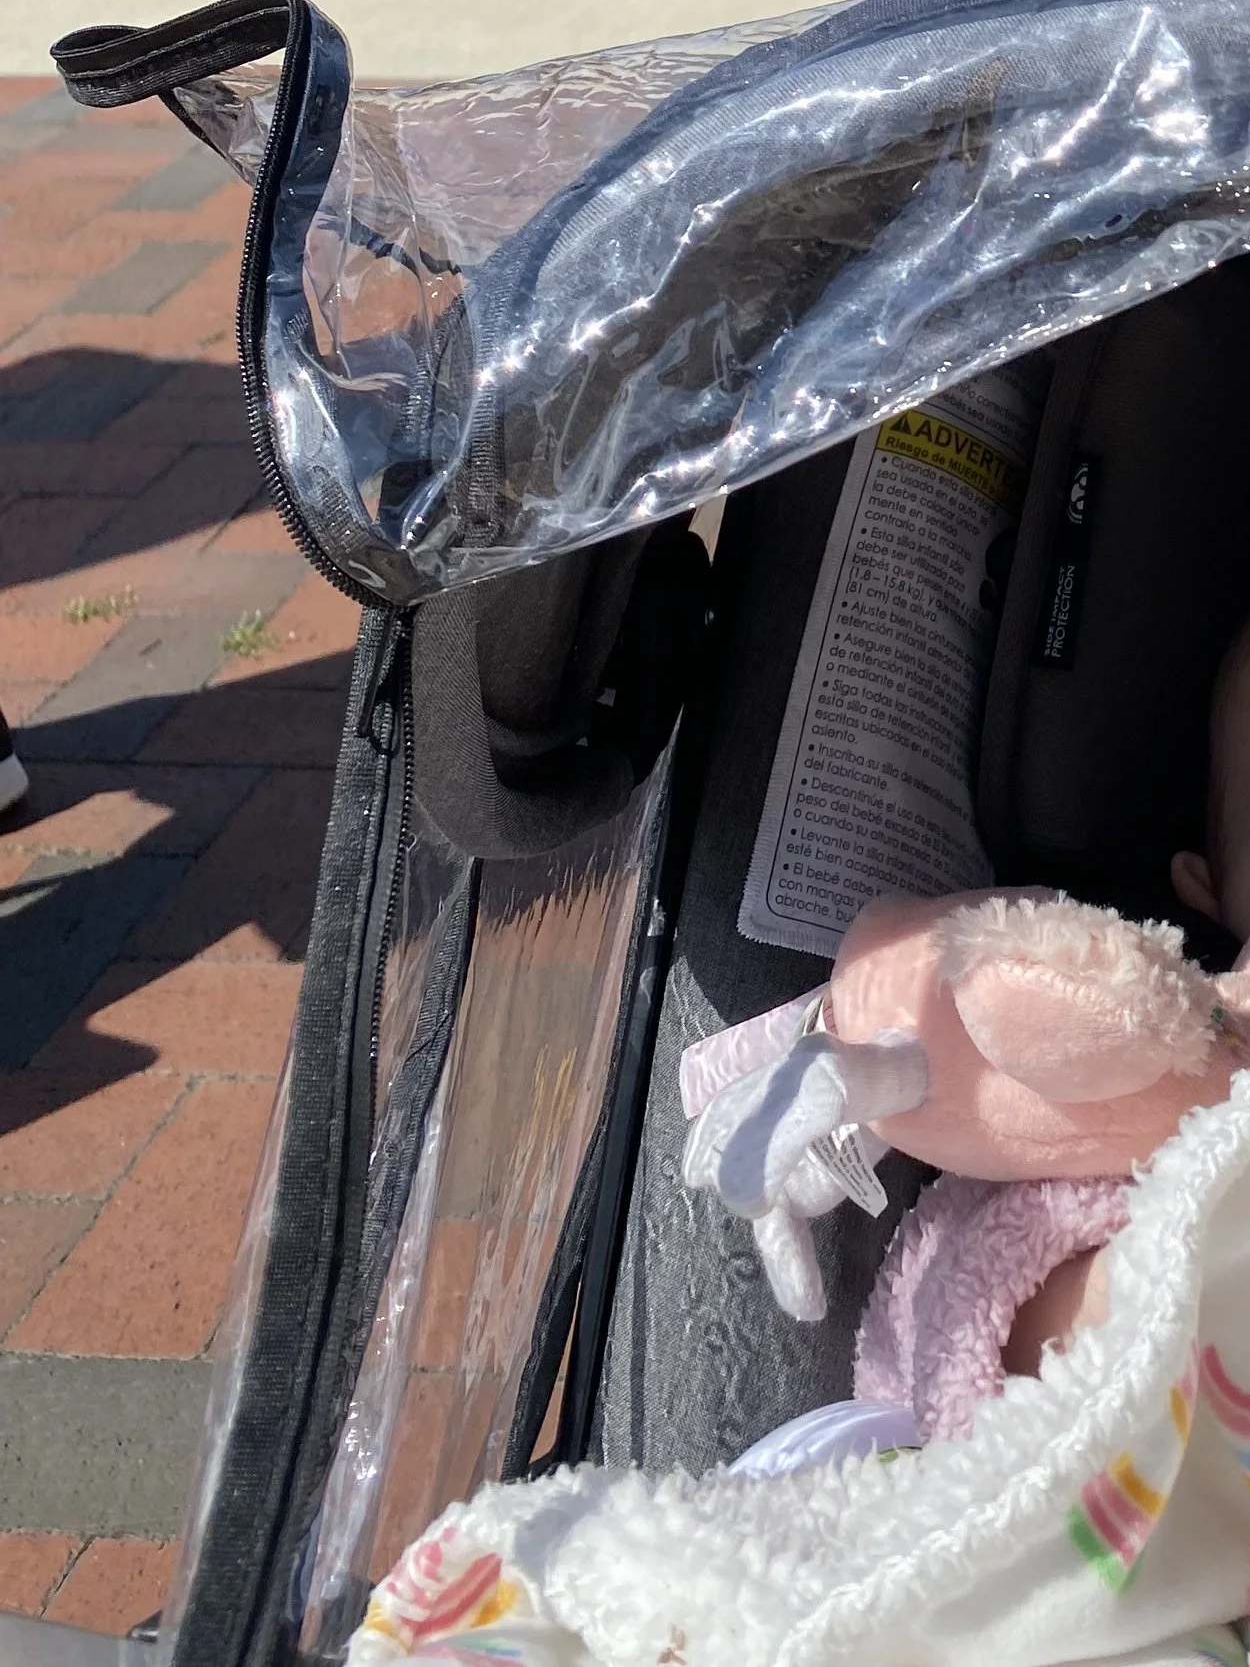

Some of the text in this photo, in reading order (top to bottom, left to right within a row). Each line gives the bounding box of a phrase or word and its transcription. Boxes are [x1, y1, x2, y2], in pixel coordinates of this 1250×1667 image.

[876, 468, 933, 494] sea usado
[885, 436, 989, 489] Riesgo de MUERTE
[891, 456, 936, 480] Cuando
[868, 495, 957, 537] mente en sentido
[872, 480, 955, 521] la debe colocar
[864, 509, 936, 541] contrario la
[856, 540, 948, 580] debe ser utilizada
[871, 527, 948, 565] Esta silla infantil
[852, 553, 915, 579] bebés que
[845, 581, 907, 608] (81 cm) de
[1051, 566, 1066, 622] IMPACT
[1051, 564, 1076, 658] PROTECTION
[836, 613, 926, 651] retención infantil
[851, 601, 912, 629] Ajuste bien
[829, 644, 933, 690] de retención infantil
[843, 633, 916, 665] Asegure bien
[826, 662, 939, 712] o mediante el cinturón
[832, 679, 908, 713] Siga todas las
[815, 707, 910, 747] escritas ubicadas
[818, 692, 929, 742] esta silla de retención
[804, 757, 890, 791] del fabricante.
[818, 743, 899, 779] Inscriba su silla
[796, 792, 827, 809] peso
[830, 798, 850, 813] del
[853, 805, 883, 825] bebé
[811, 777, 913, 820] Descontinúe el uso
[801, 826, 884, 863] Levante la silla
[805, 811, 899, 849] cuando su altura
[786, 842, 899, 885] esté bien acoplada
[793, 862, 875, 897] El bebé debe
[774, 893, 831, 918] abroche,
[778, 878, 855, 907] con mangas
